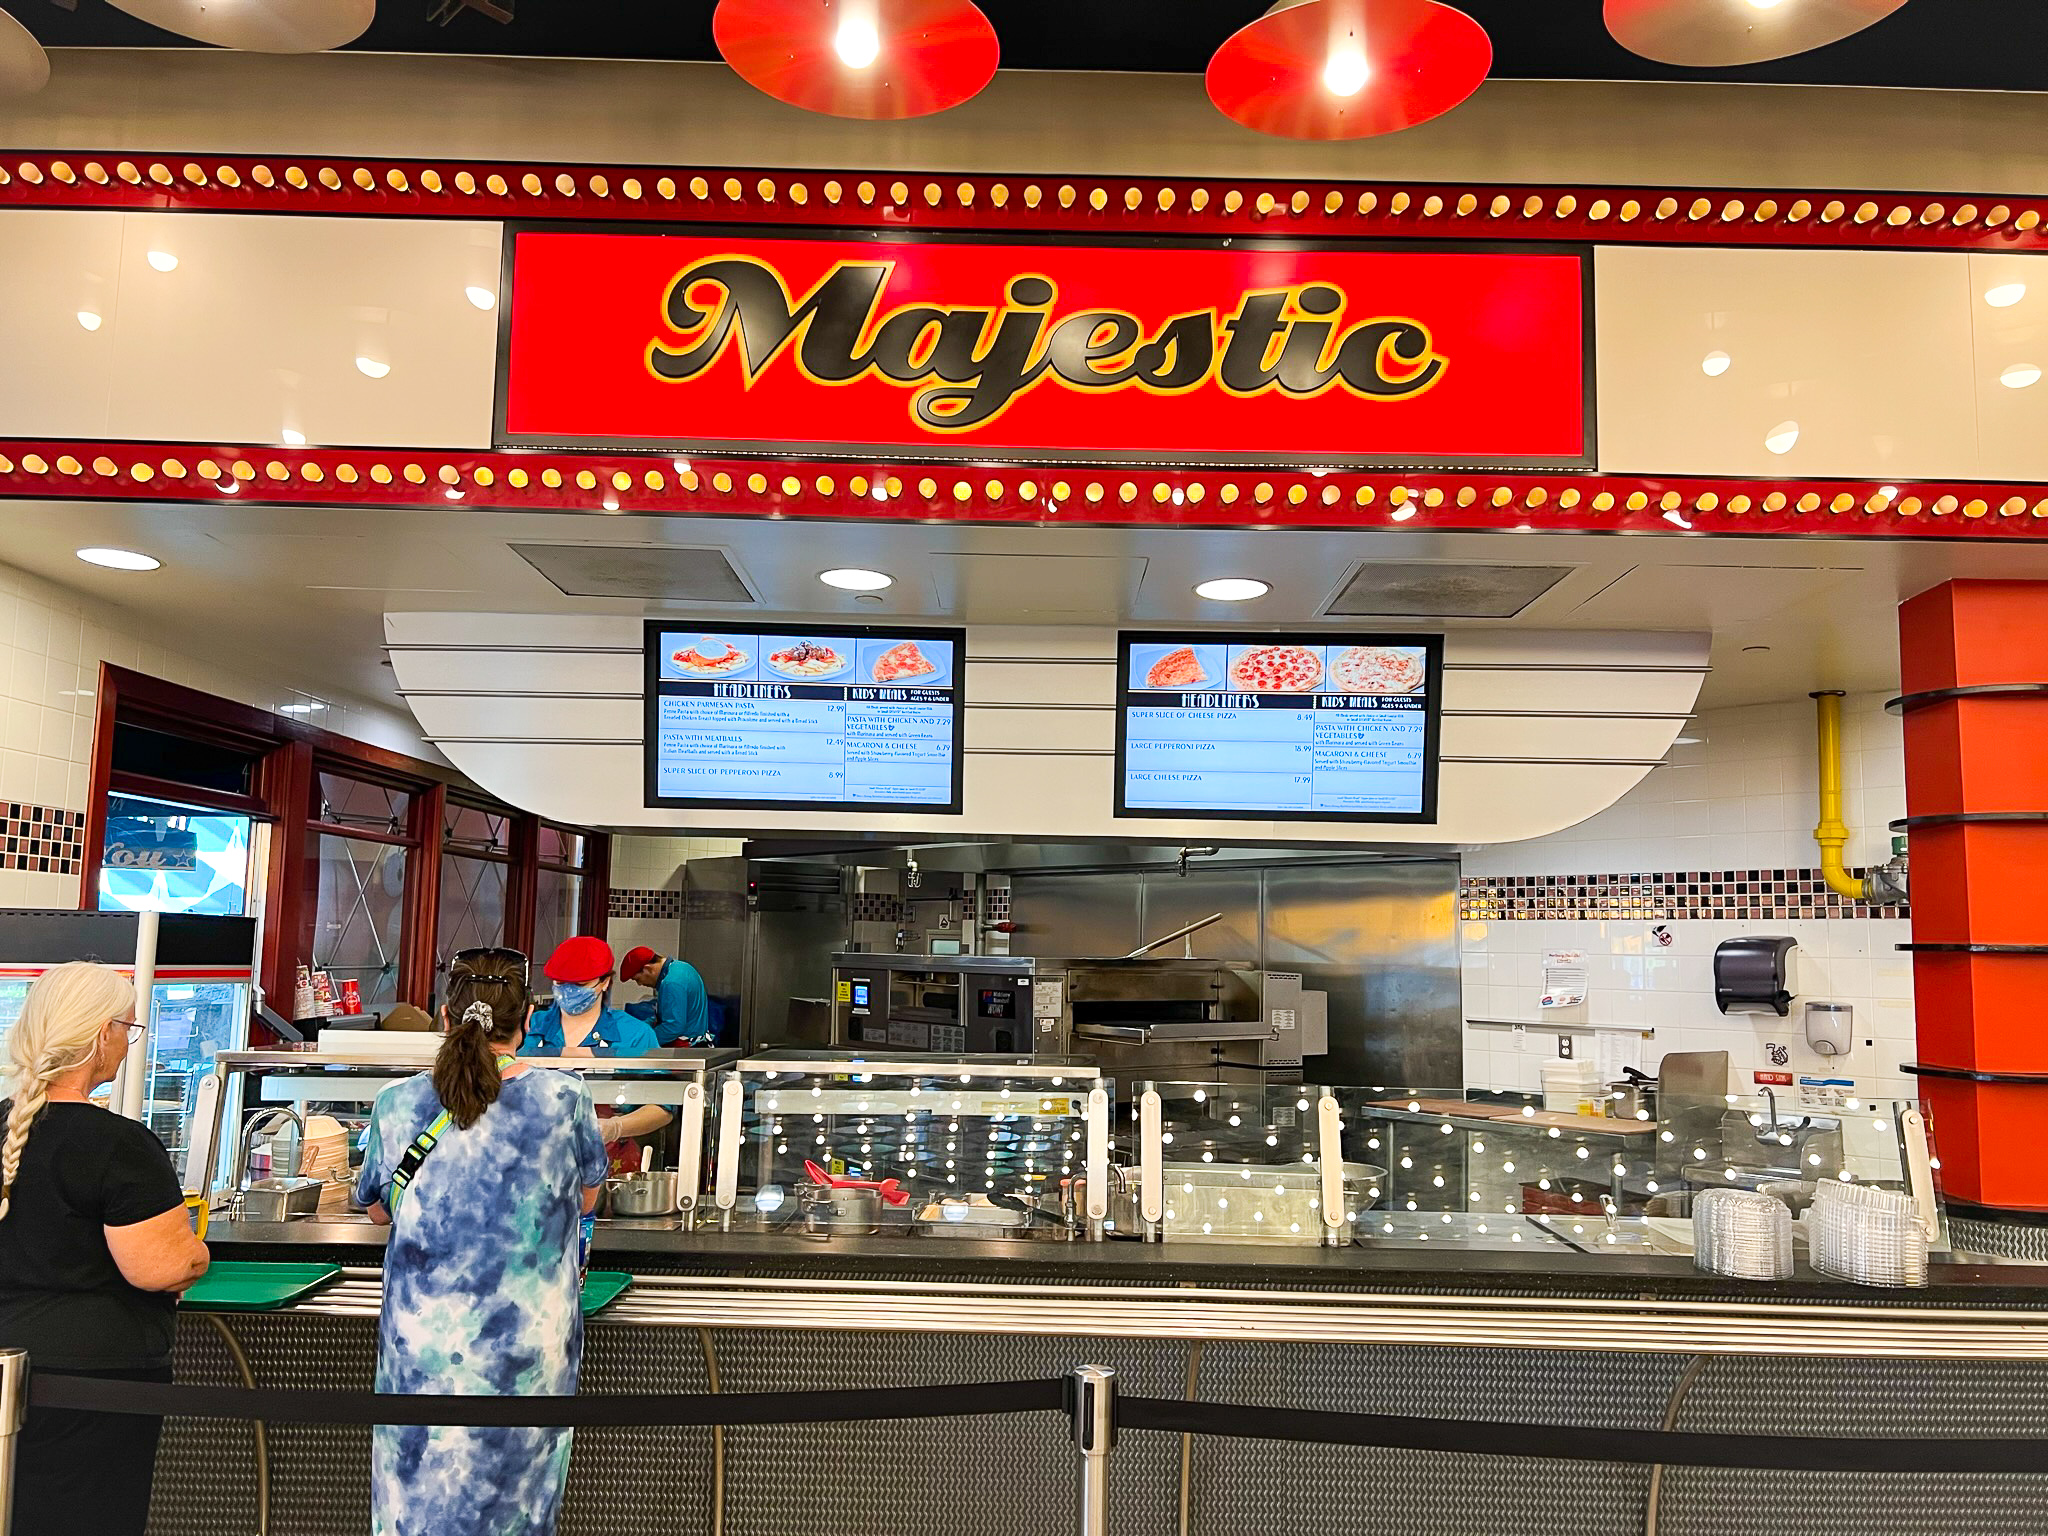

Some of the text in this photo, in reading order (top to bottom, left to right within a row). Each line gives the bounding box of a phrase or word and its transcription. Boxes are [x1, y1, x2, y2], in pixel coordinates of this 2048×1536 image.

[646, 253, 1450, 433] Majestic
[713, 683, 791, 699] HEADLINERS
[852, 688, 907, 700] KIDS' MEALS
[1181, 694, 1259, 708] HEADLINERS
[1321, 696, 1378, 708] KIDS' MEALS
[720, 768, 760, 776] PEPPERONI
